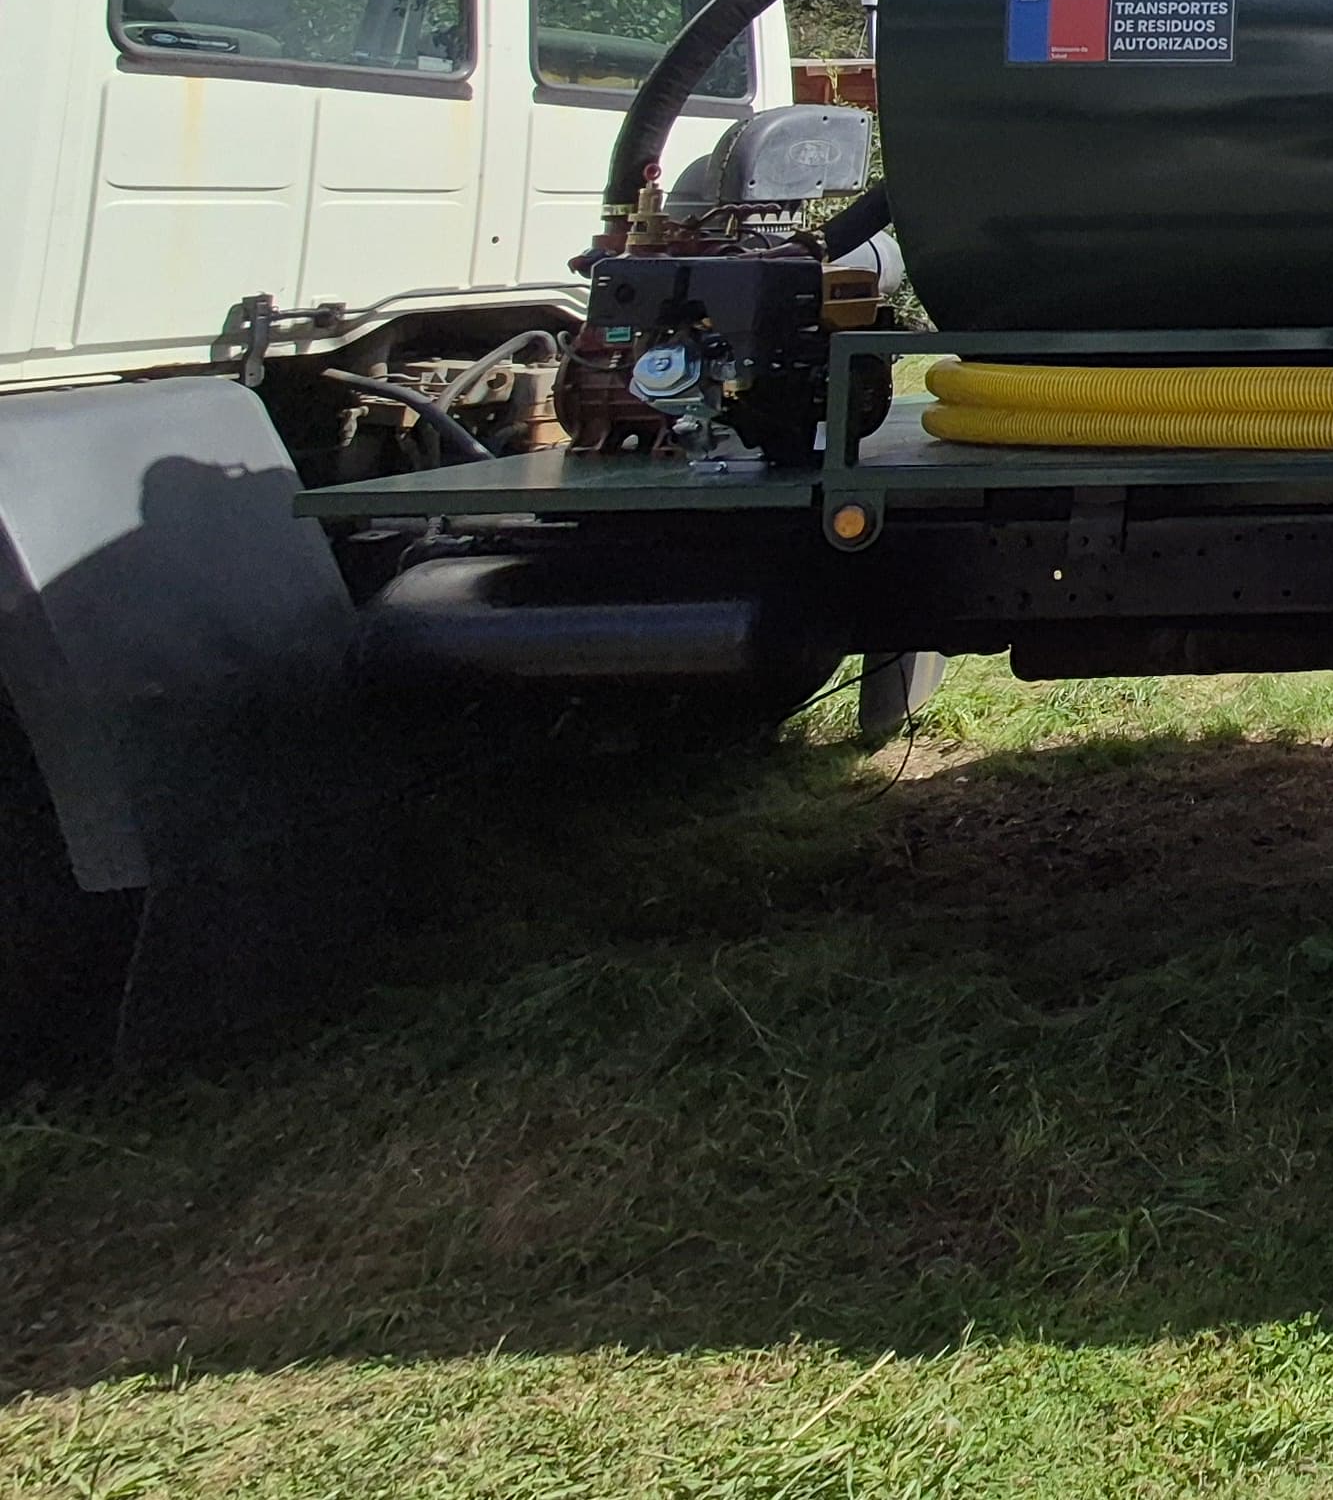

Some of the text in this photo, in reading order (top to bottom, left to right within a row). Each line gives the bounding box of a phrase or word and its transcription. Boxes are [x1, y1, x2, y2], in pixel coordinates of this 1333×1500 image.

[1114, 1, 1229, 15] TRANSPORTES
[1114, 19, 1216, 33] DE RESIDUOS
[1113, 37, 1229, 51] AUTORIZADOS
